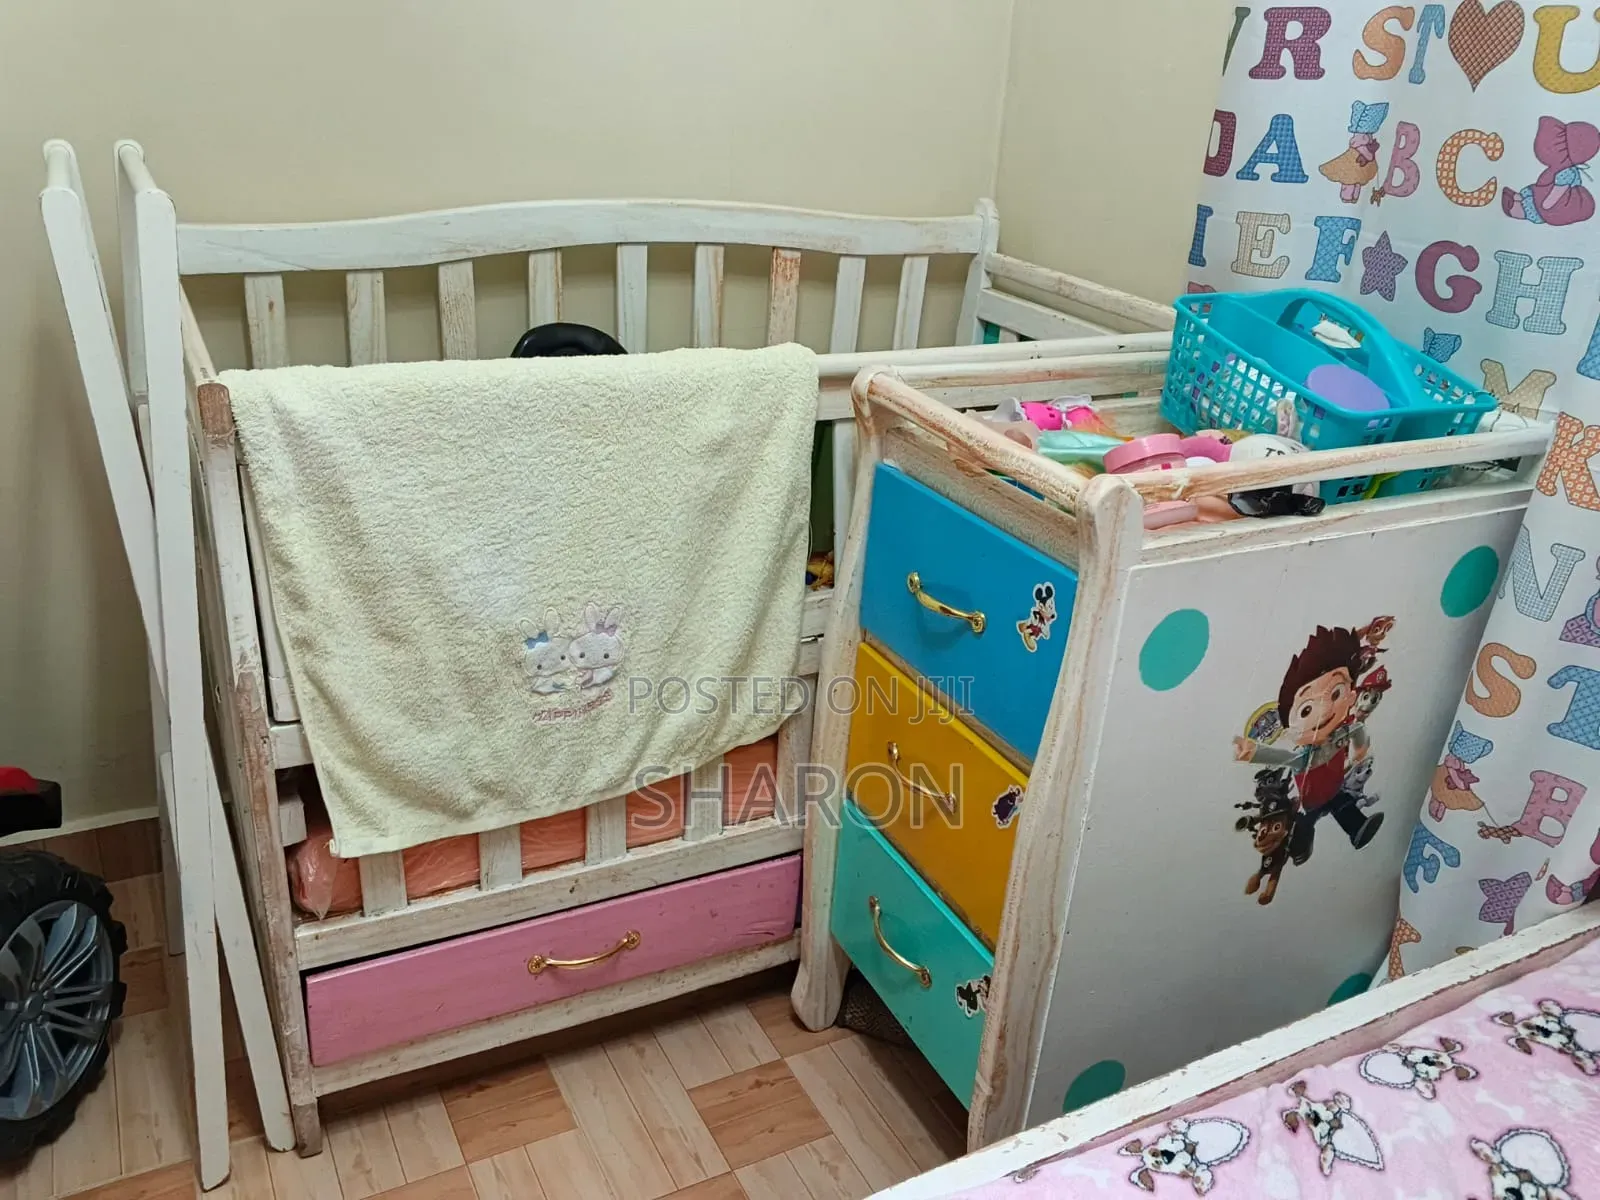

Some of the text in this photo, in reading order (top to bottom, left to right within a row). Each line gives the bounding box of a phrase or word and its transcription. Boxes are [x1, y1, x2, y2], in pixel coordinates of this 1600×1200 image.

[1249, 6, 1332, 80] R
[1352, 6, 1415, 80] S
[1533, 5, 1600, 94] U
[1235, 113, 1309, 183] A
[1436, 128, 1504, 207] C
[1231, 211, 1291, 279] E
[1305, 215, 1362, 283] F
[1415, 240, 1482, 313] G
[1485, 250, 1584, 334] H
[1536, 411, 1600, 512] K
[1465, 642, 1537, 718] S
